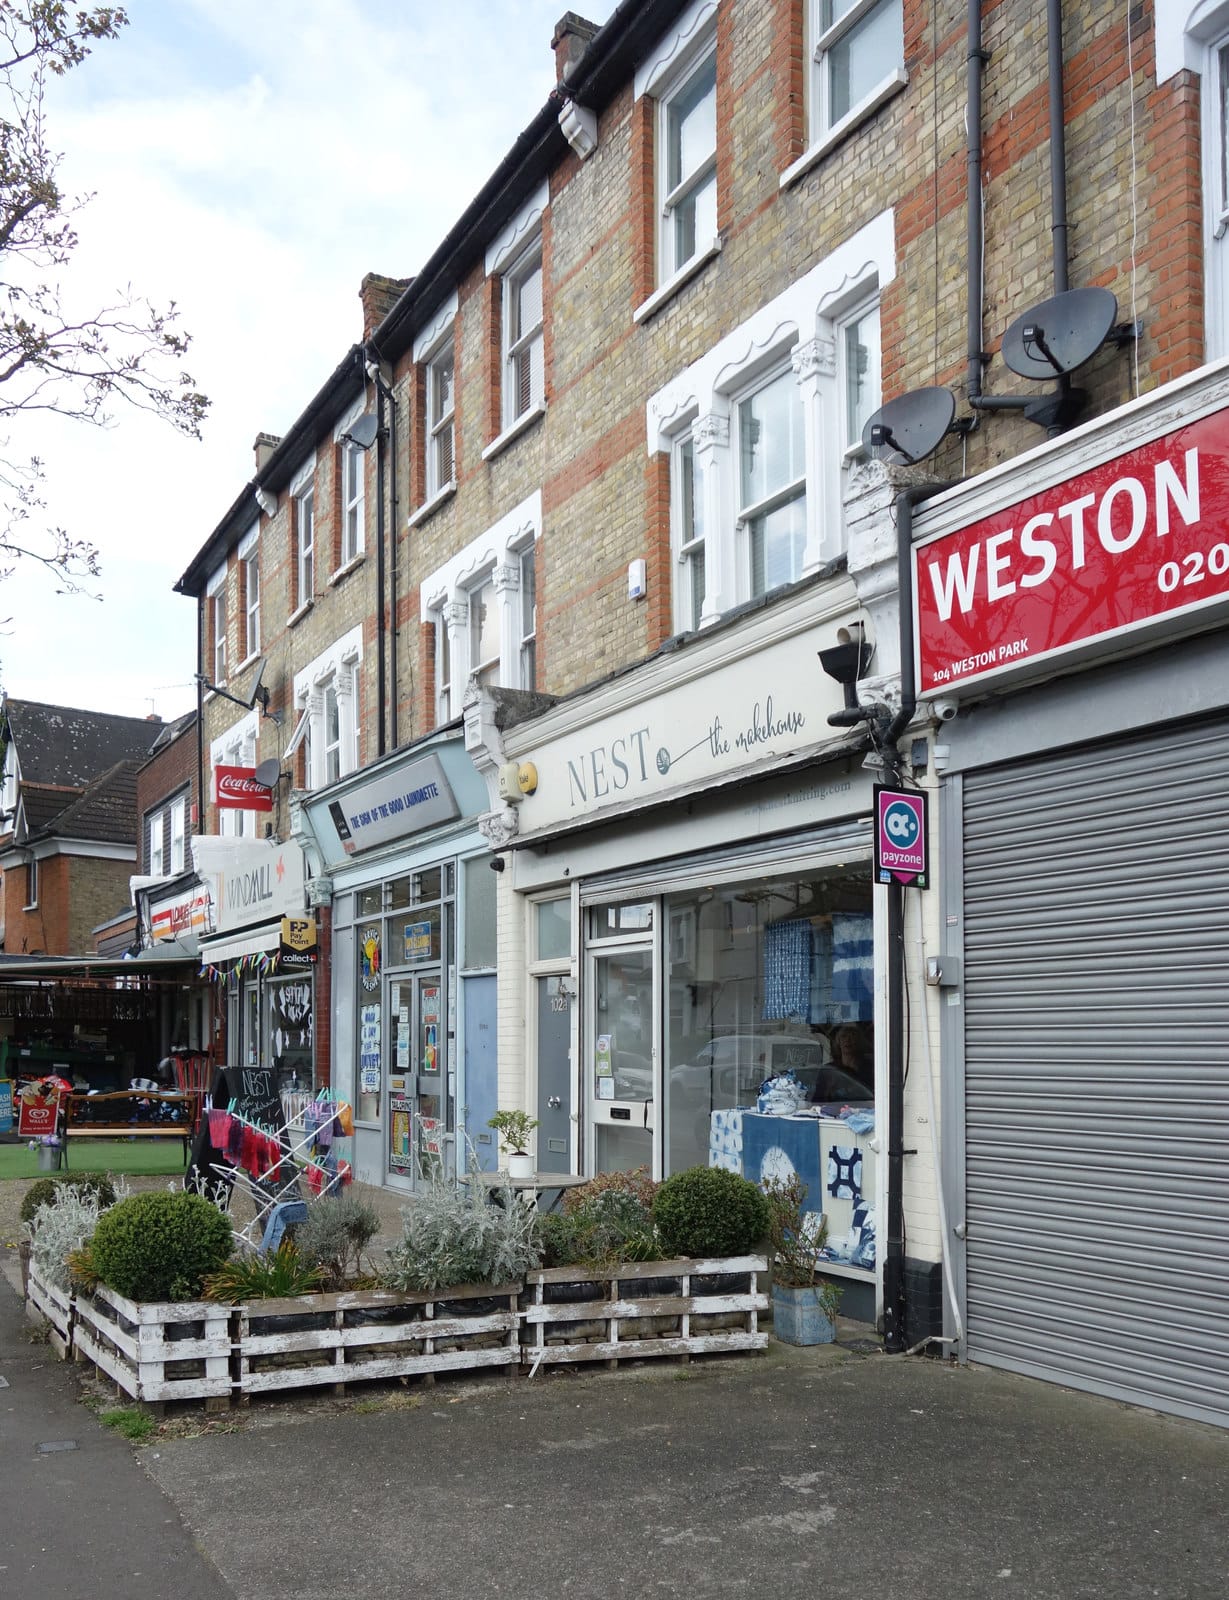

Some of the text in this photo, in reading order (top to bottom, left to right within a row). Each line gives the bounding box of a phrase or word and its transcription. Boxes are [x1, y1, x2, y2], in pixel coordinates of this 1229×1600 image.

[928, 446, 1201, 623] WESTON
[933, 638, 1029, 682] 104 WESTON PARK
[708, 695, 806, 759] the makehouse
[567, 727, 651, 807] NEST
[350, 817, 360, 829] THE
[359, 811, 372, 827] SIGN
[371, 808, 379, 822] OF
[378, 803, 389, 819] THE
[388, 798, 405, 816] GOOD
[882, 851, 922, 865] payzone
[290, 933, 303, 941] Pay
[282, 954, 317, 963] collect+
[241, 1070, 271, 1097] NEST
